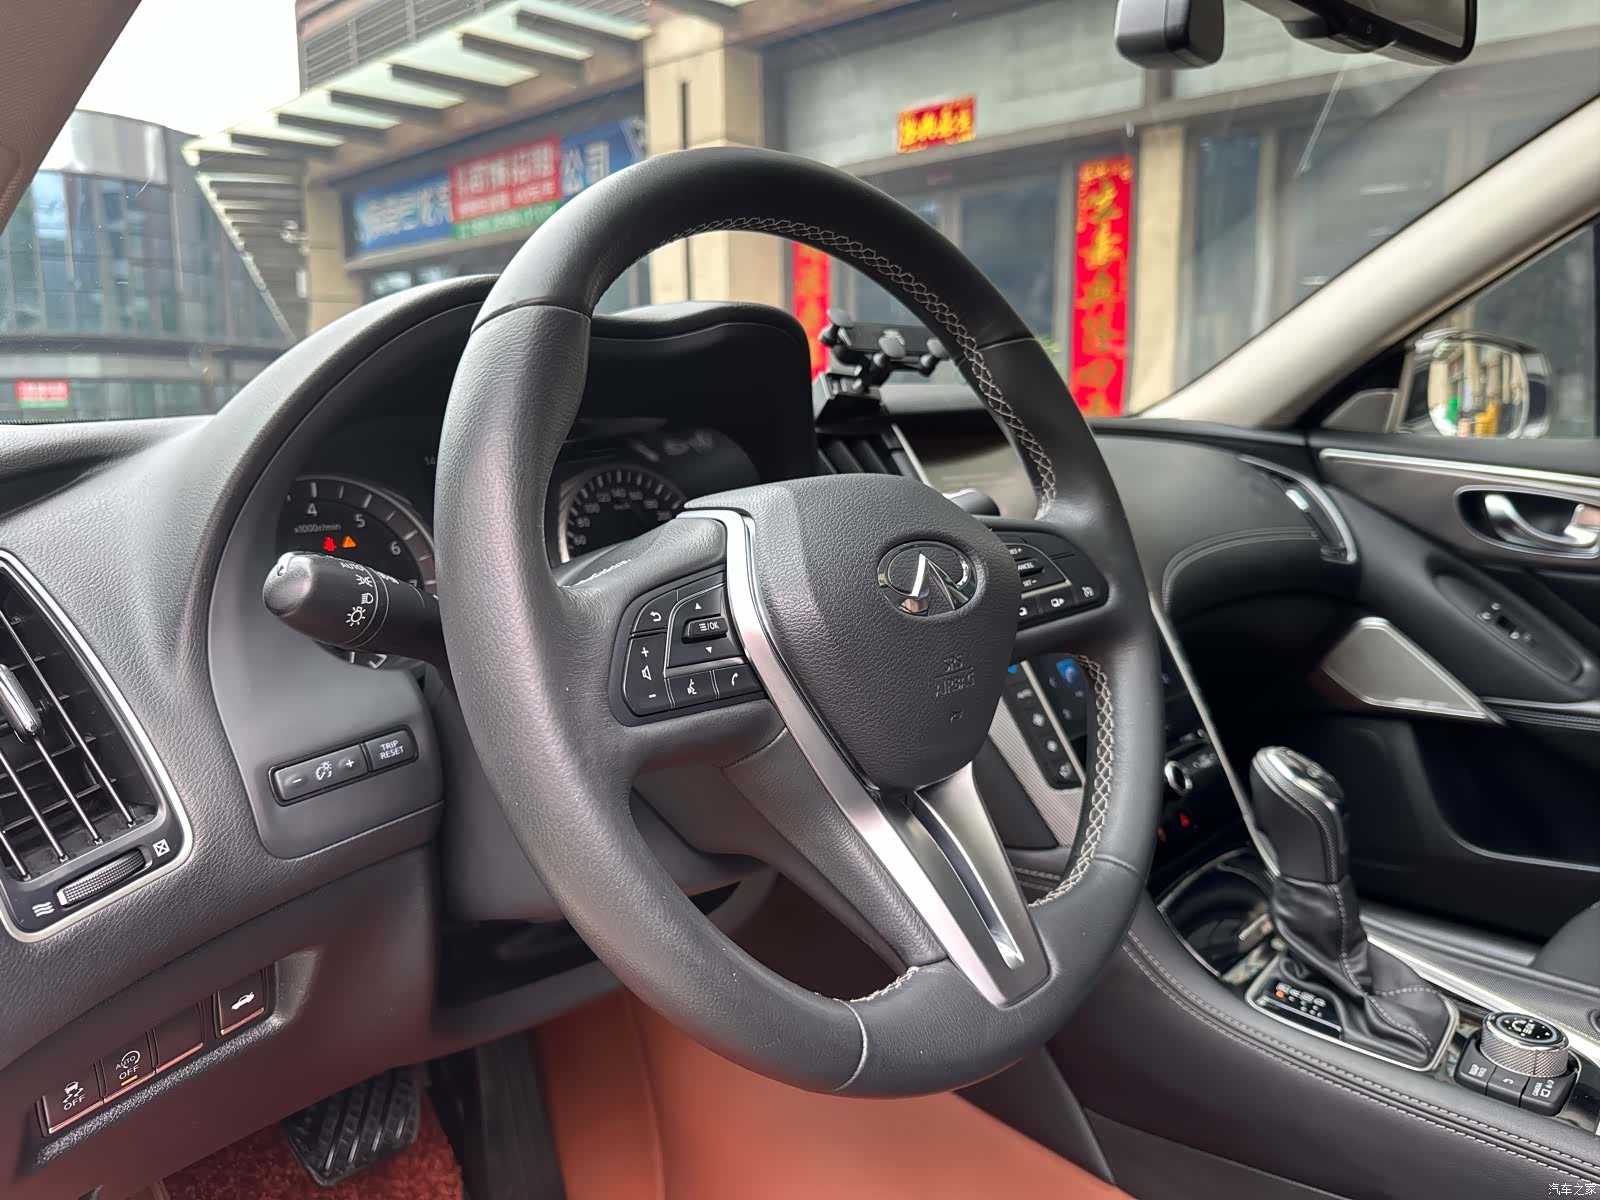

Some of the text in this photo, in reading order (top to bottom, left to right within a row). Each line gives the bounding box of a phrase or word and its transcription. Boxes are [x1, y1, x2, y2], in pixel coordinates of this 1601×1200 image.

[307, 503, 318, 516] 4
[354, 514, 366, 528] 5
[391, 541, 402, 555] 6
[1017, 562, 1035, 571] ANCEL
[379, 745, 404, 760] RESET
[380, 740, 399, 751] TRIP
[115, 1054, 137, 1070] AUTO
[119, 1064, 139, 1080] OFF
[63, 1095, 86, 1111] OFF
